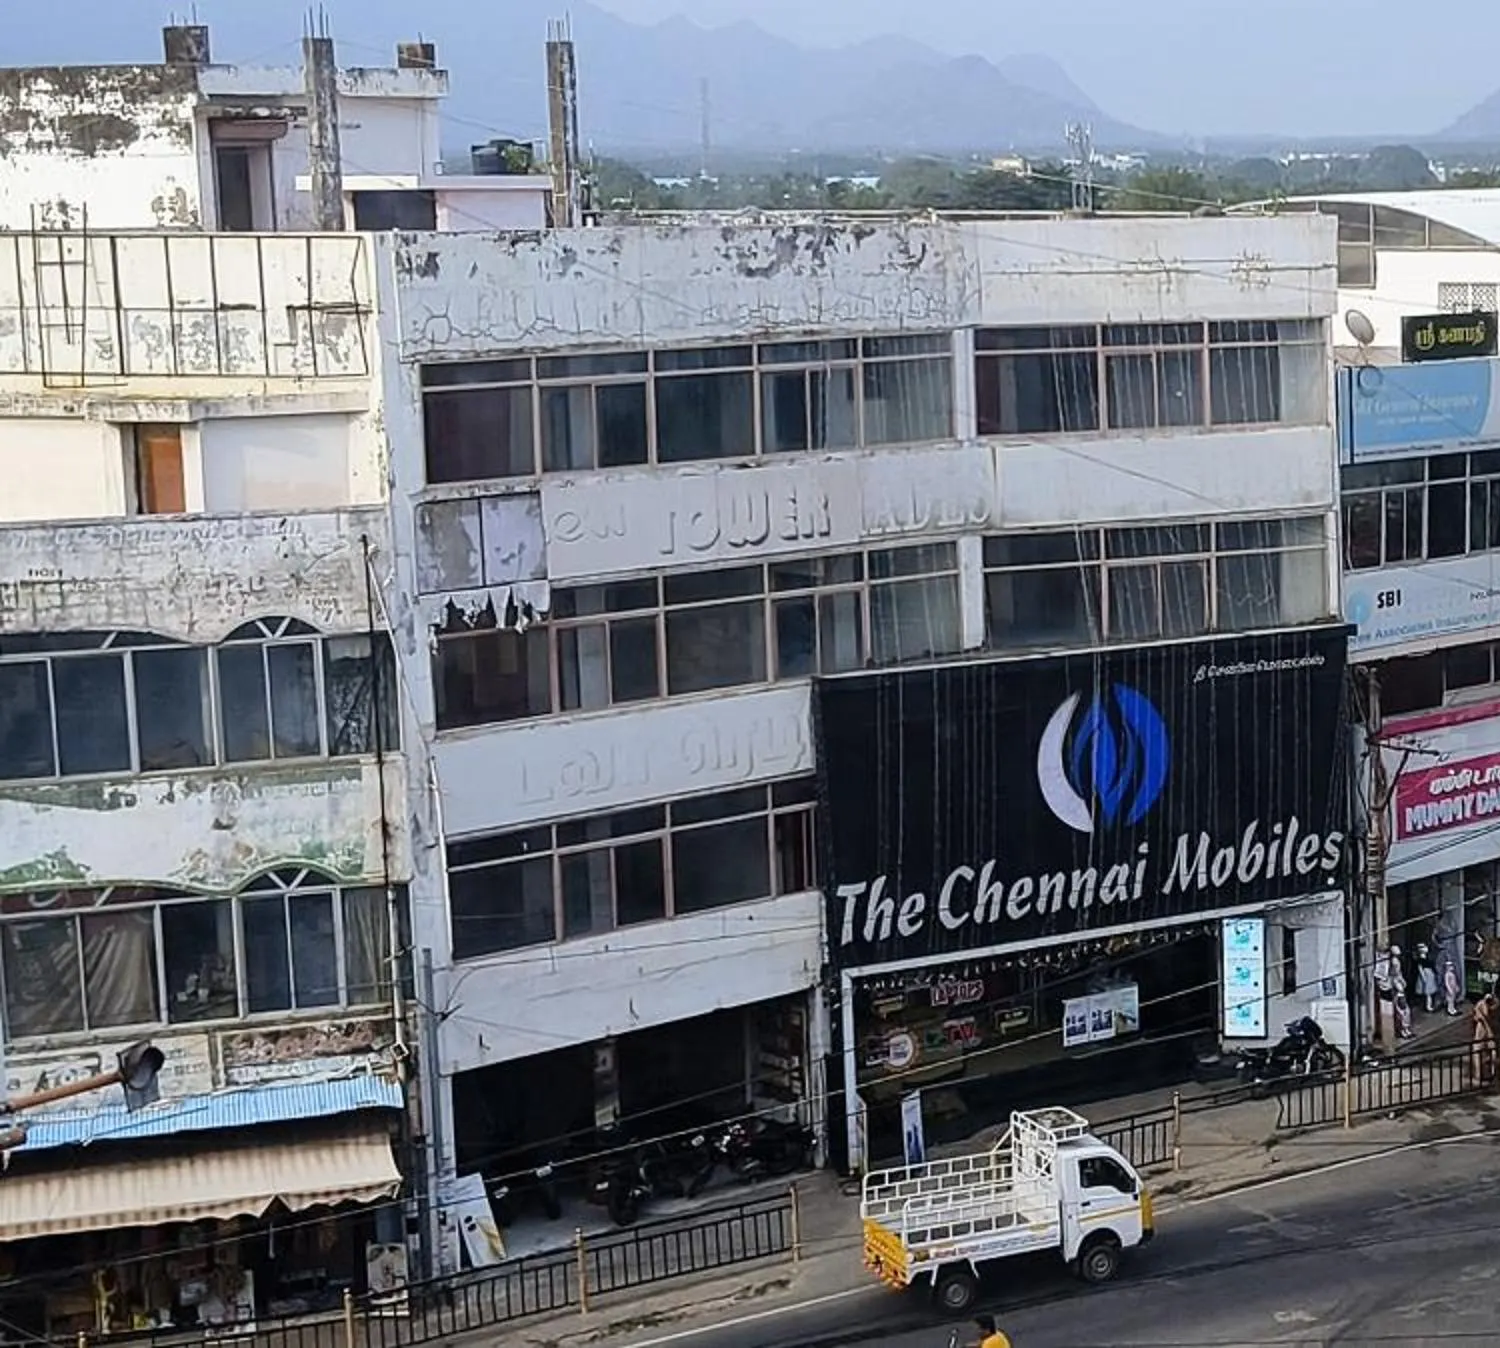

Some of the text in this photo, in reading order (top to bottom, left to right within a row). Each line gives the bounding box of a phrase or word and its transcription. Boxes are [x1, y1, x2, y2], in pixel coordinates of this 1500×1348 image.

[1376, 588, 1402, 609] SBI
[1405, 792, 1475, 833] MUMMY
[836, 815, 1345, 945] The Chennai Mobiles
